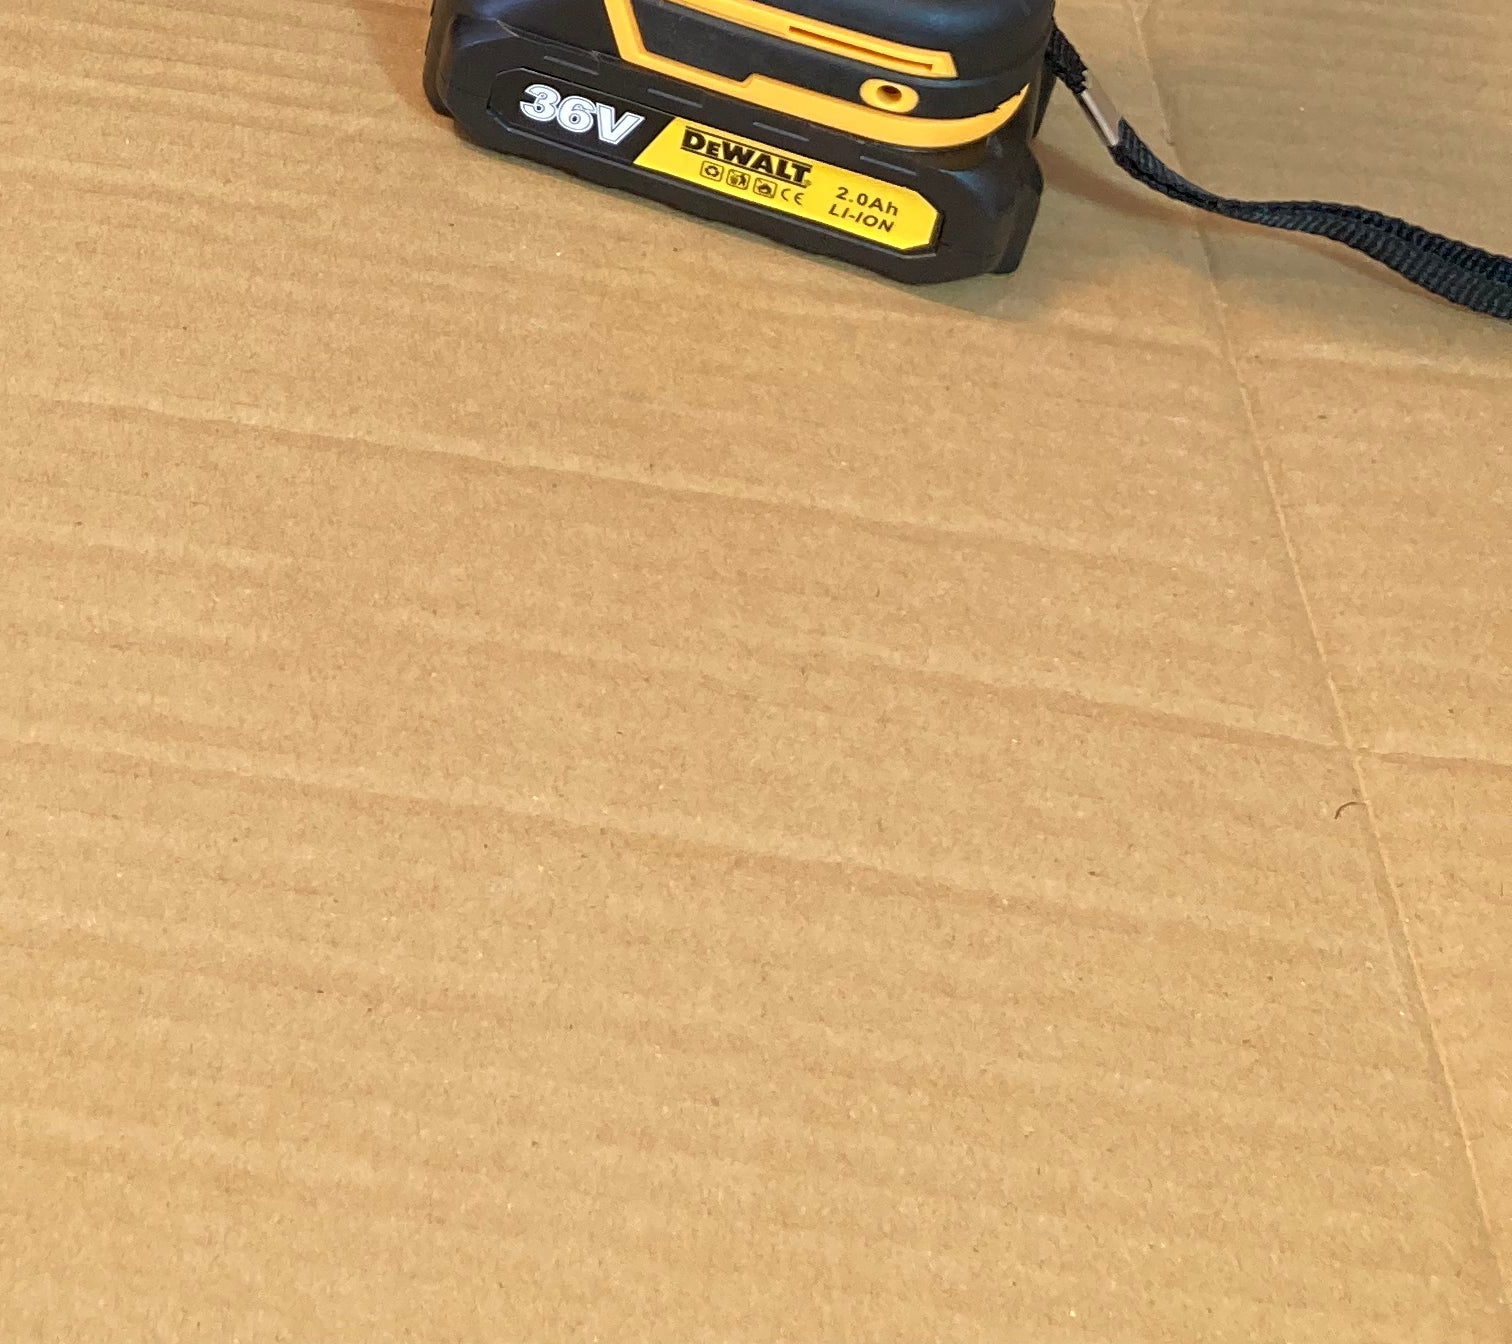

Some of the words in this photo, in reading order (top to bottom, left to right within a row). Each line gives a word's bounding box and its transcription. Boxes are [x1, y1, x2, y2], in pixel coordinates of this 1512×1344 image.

[518, 82, 647, 146] 36V
[680, 126, 813, 189] DeWALT
[828, 202, 896, 233] LI-ION
[836, 185, 899, 217] 2.0Ah
